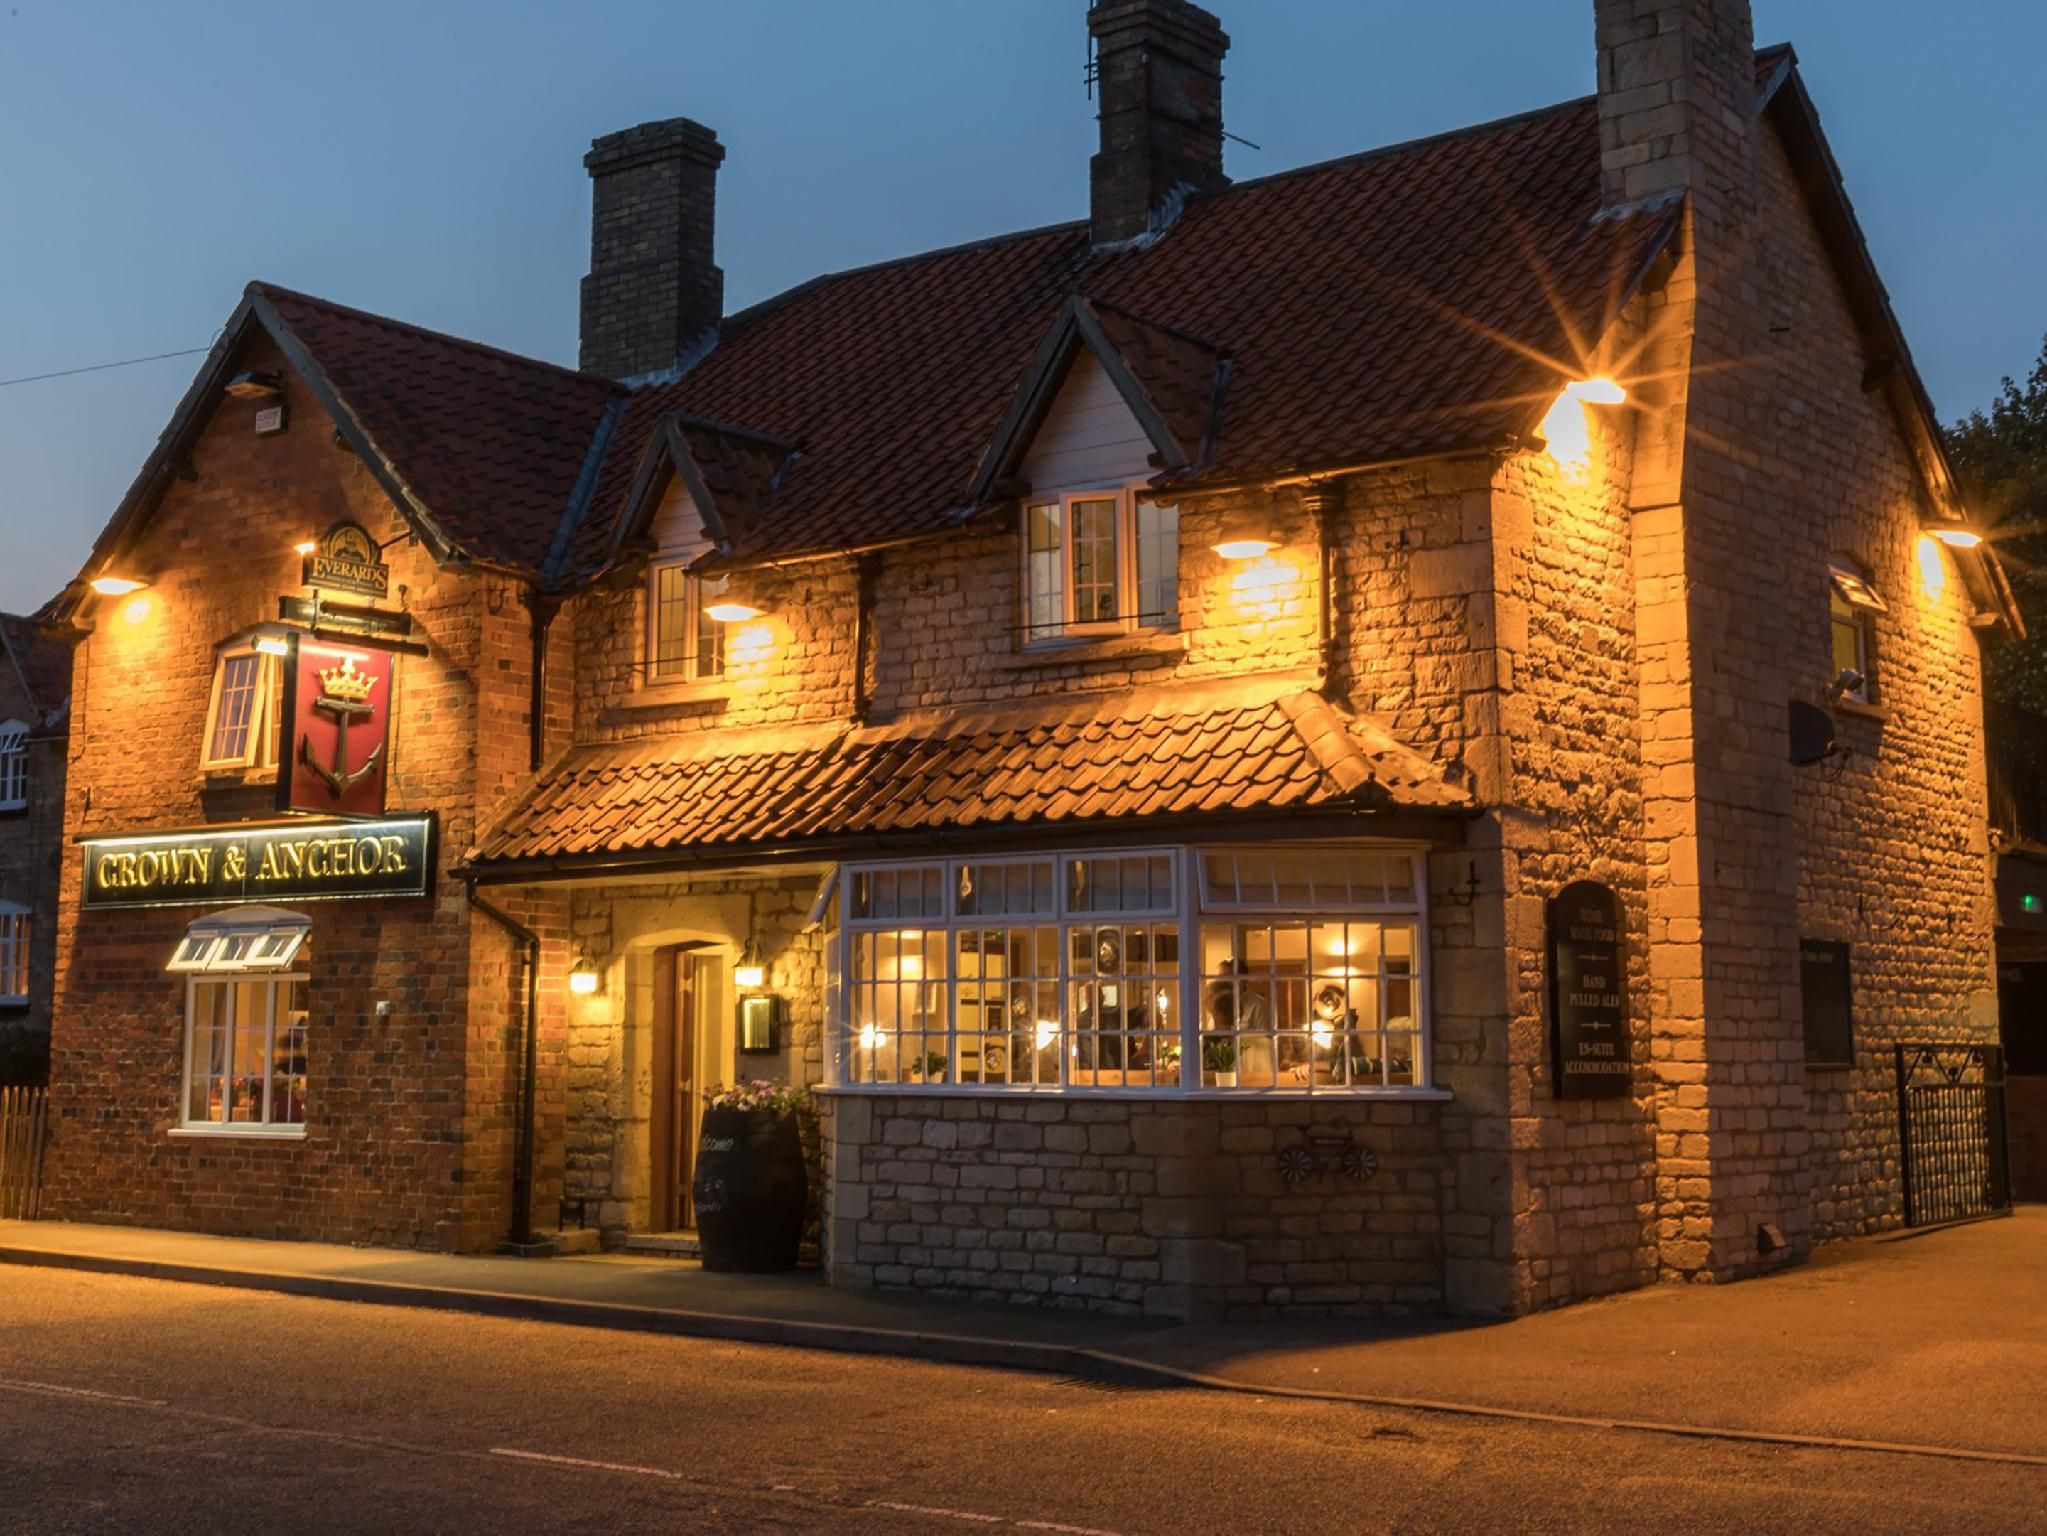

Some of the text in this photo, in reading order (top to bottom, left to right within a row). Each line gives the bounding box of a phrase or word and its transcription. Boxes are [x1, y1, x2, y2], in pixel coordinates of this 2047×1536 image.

[313, 558, 387, 590] EVERARDS
[98, 837, 408, 888] CROWN & ANCHOR
